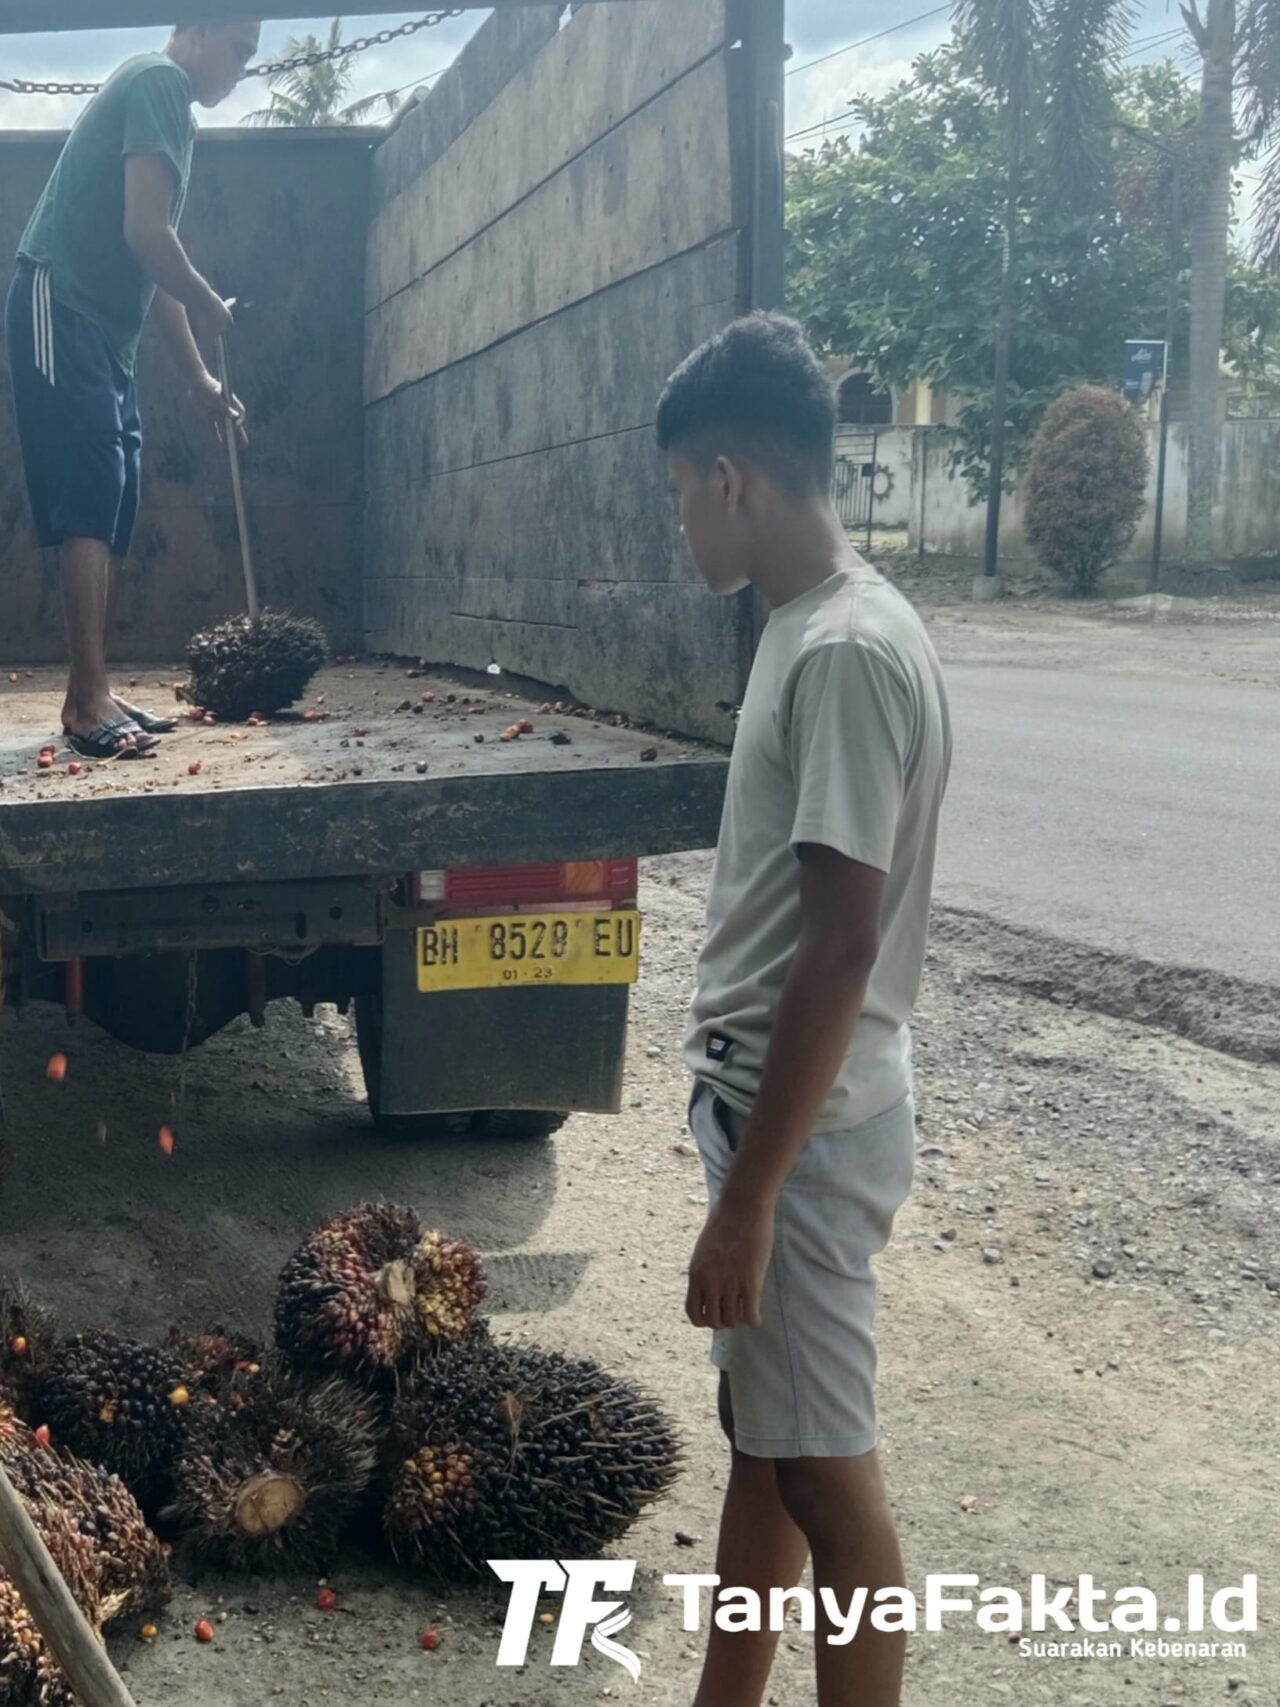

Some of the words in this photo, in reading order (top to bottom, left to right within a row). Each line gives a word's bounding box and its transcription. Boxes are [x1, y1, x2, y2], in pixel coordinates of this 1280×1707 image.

[422, 928, 459, 967] BH
[490, 920, 569, 961] 8528
[593, 918, 634, 958] EU
[502, 968, 518, 981] 01
[533, 966, 554, 979] 23
